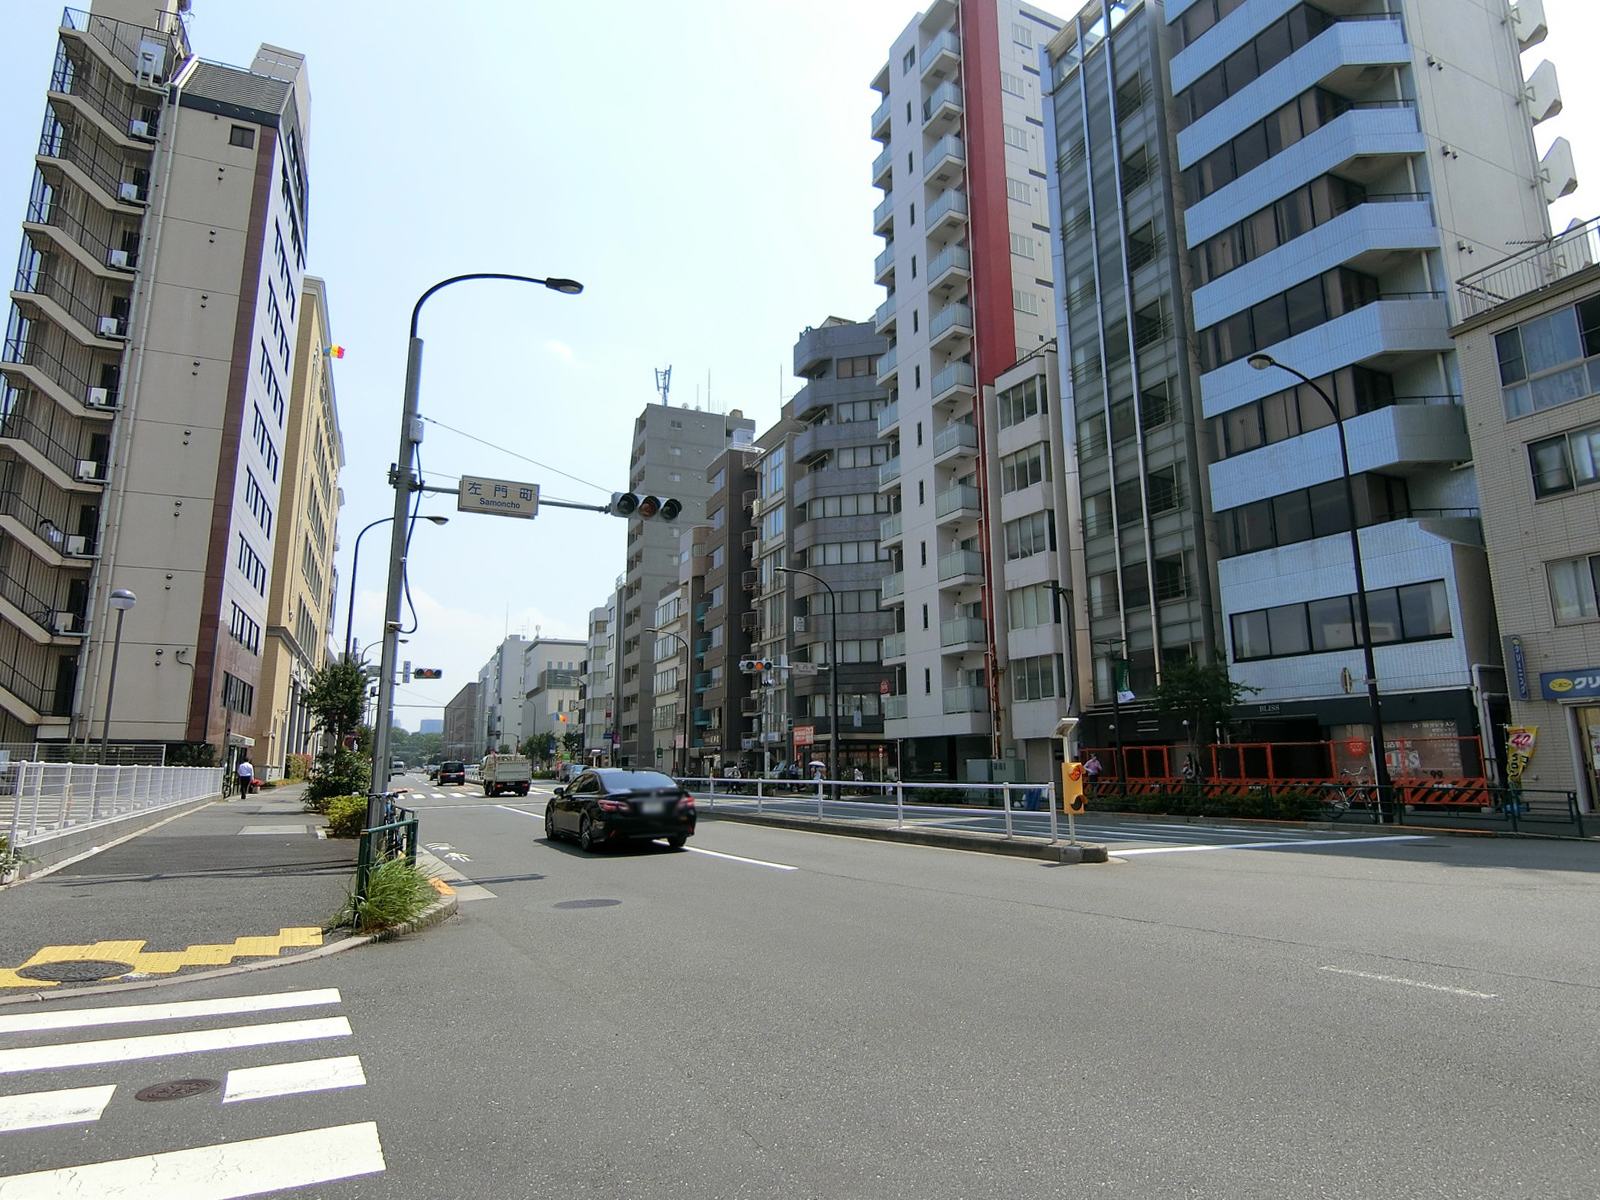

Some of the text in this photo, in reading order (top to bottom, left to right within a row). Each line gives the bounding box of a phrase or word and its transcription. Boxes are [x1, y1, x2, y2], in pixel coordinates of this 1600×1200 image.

[467, 482, 534, 502] 左門町
[479, 497, 521, 509] Samoncho
[1514, 645, 1526, 694] クリーニング
[1258, 704, 1280, 712] BLISS
